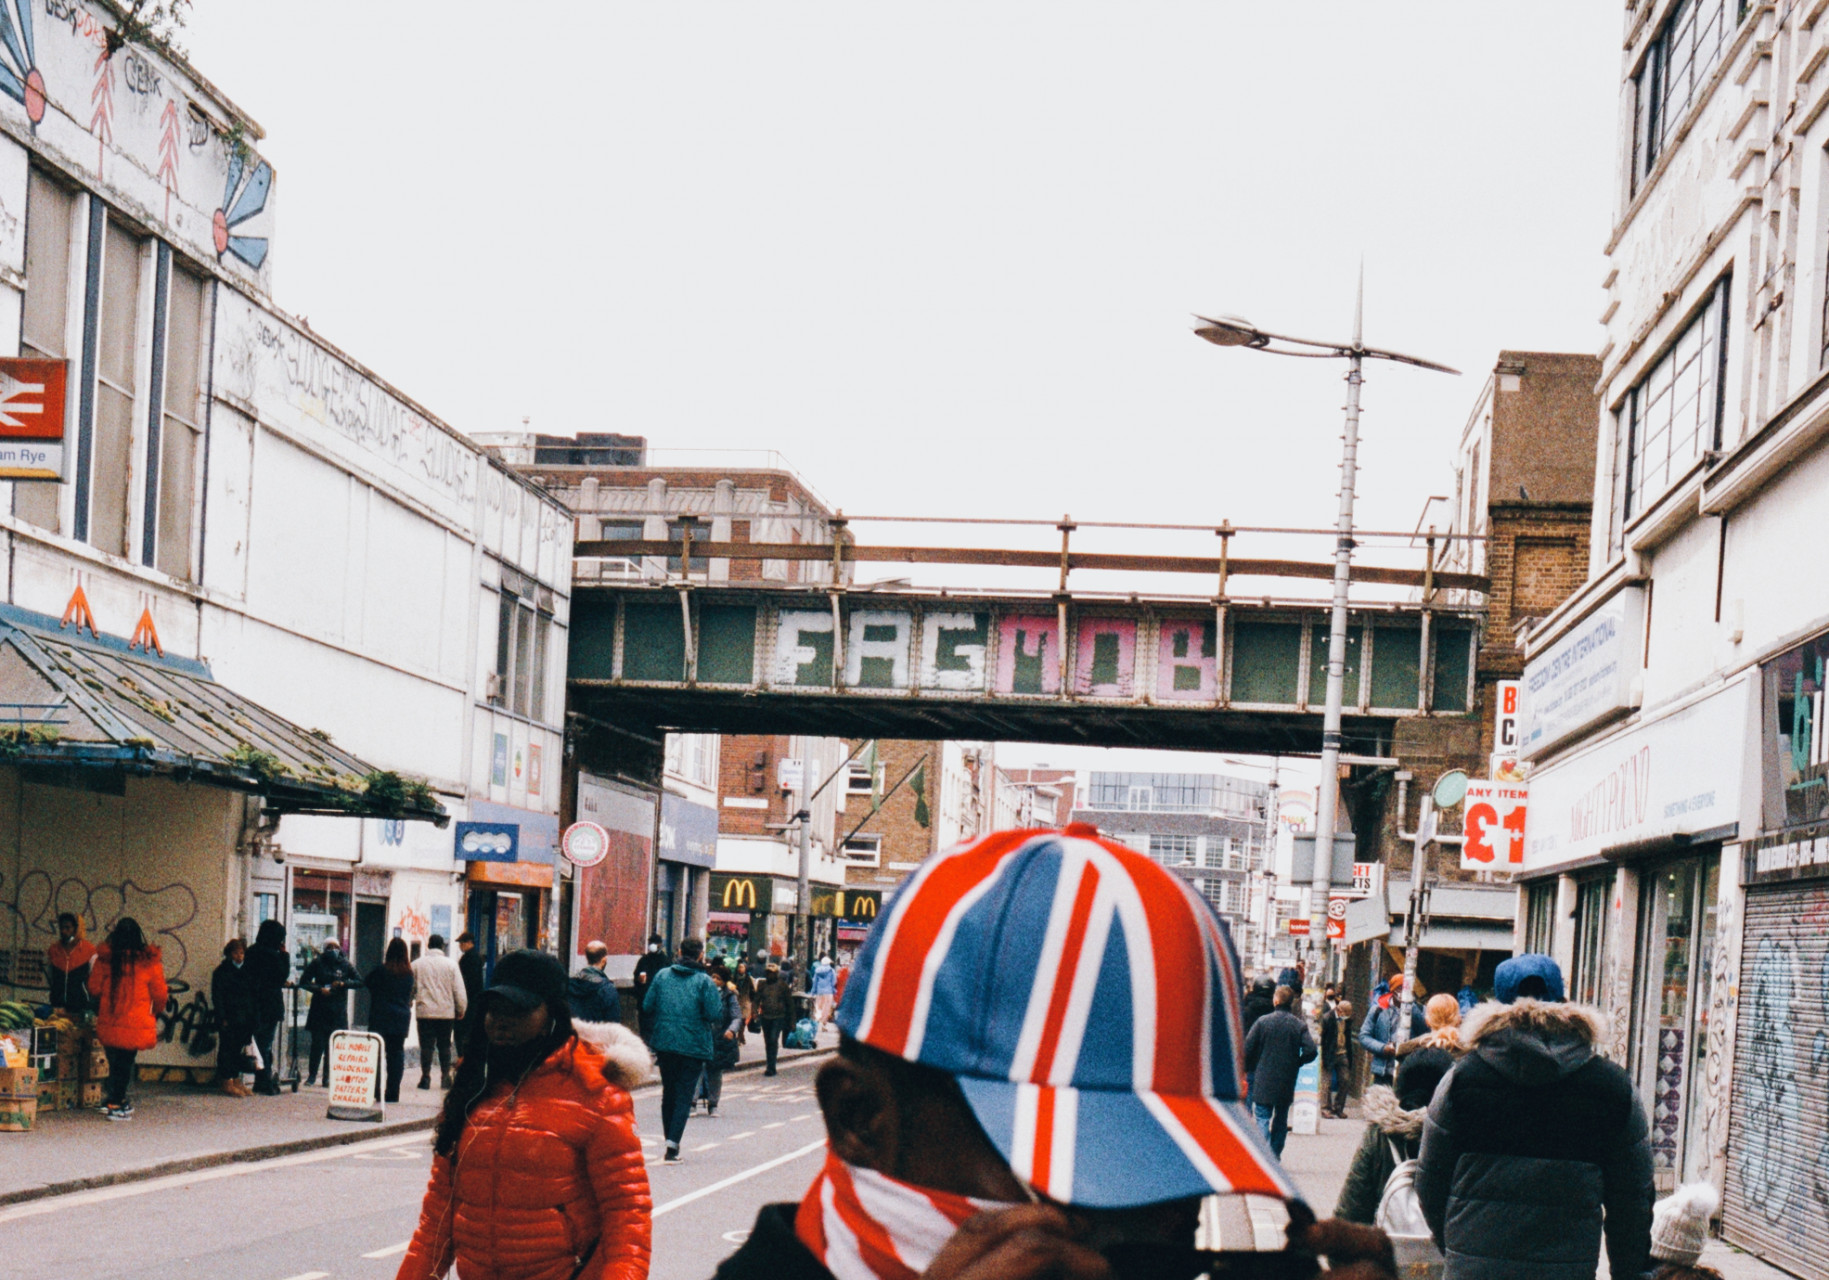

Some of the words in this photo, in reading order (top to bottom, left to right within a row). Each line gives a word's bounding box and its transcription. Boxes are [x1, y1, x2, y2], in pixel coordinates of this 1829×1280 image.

[20, 449, 46, 464] Rye
[775, 609, 987, 691] FAG
[996, 614, 1219, 700] MOB
[1503, 686, 1520, 714] B
[1501, 718, 1519, 746] C
[1467, 787, 1493, 798] ANY
[1498, 789, 1528, 800] ITEM
[335, 1042, 346, 1050] ALL
[349, 1042, 372, 1052] MOBILE
[338, 1053, 368, 1063] REPAIRS
[333, 1064, 375, 1074] UNLOCKING
[334, 1083, 368, 1095] BATTERY
[332, 1094, 367, 1104] CHARGER
